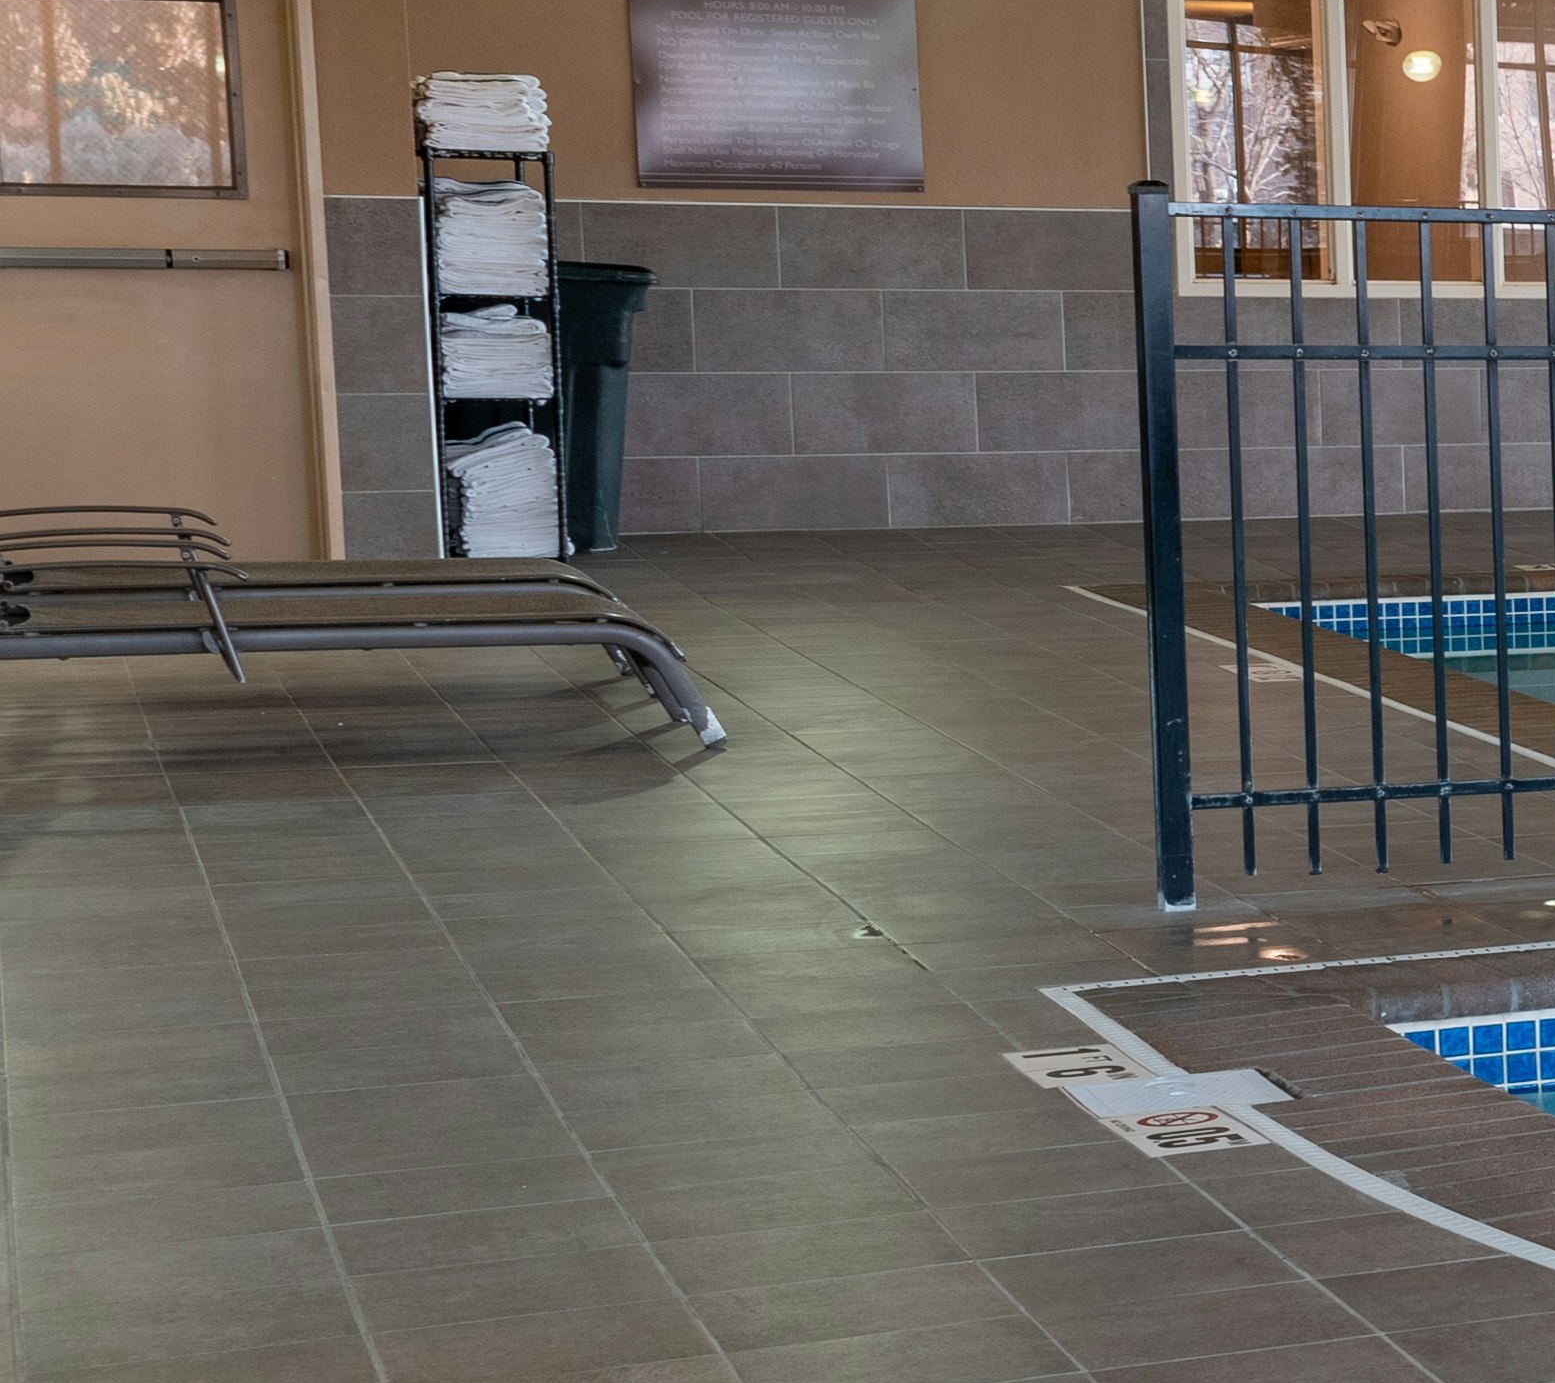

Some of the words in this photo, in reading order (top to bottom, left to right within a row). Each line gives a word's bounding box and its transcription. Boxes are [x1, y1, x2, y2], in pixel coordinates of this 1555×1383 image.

[670, 10, 702, 20] POOL
[706, 11, 730, 20] FOR
[732, 12, 800, 23] REGISTERED
[802, 14, 844, 24] GUESTS
[656, 24, 672, 32] No
[656, 37, 677, 46] NO
[1046, 1065, 1126, 1078] 6
